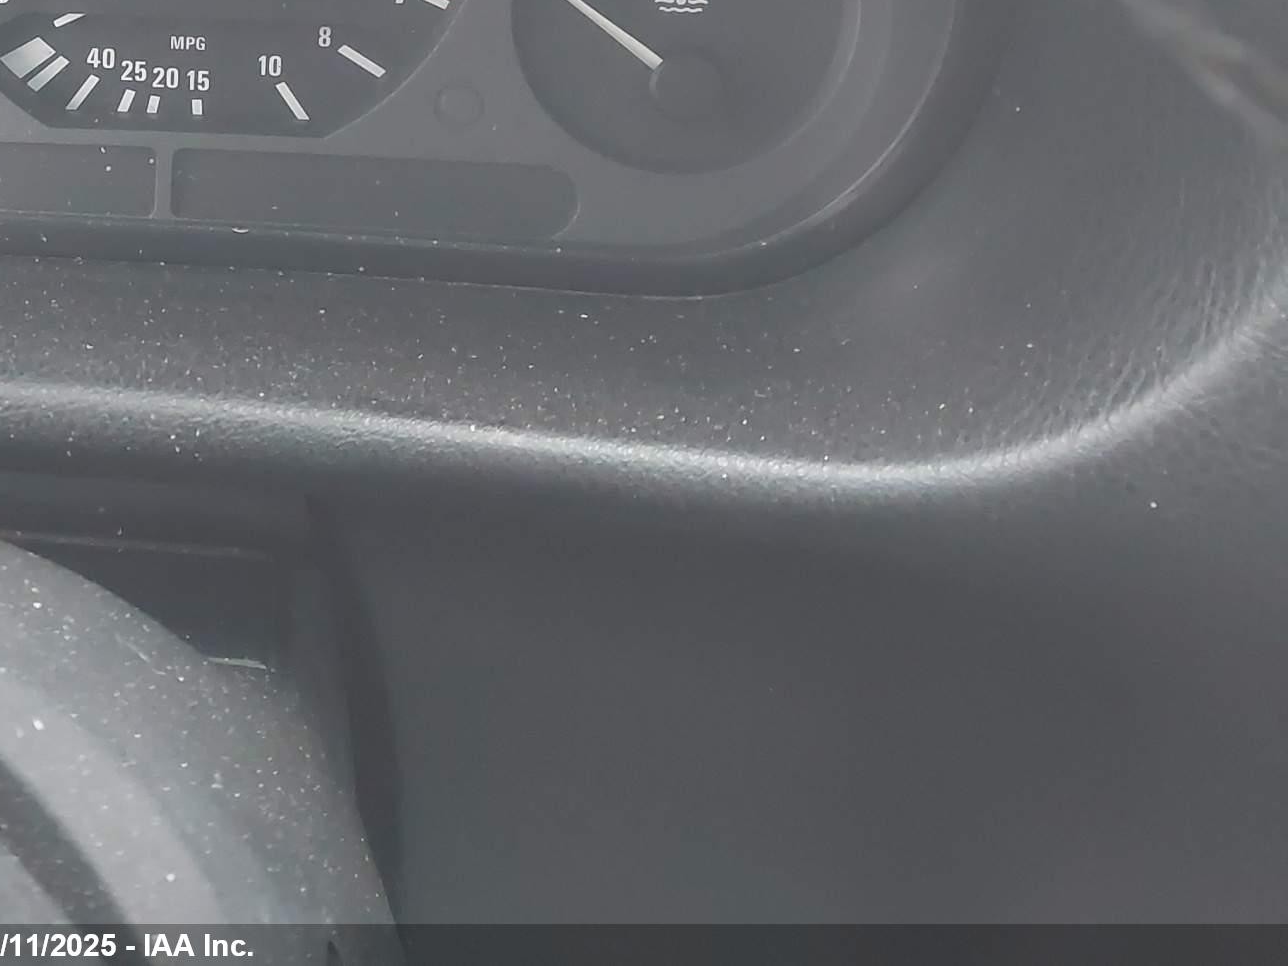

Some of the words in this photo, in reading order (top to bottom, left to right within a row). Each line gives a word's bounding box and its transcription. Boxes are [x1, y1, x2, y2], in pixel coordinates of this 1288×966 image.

[170, 35, 206, 51] MPG
[318, 26, 332, 47] 8
[86, 47, 115, 69] 40
[258, 55, 282, 77] 10
[120, 60, 147, 82] 25
[152, 67, 179, 89] 20
[186, 70, 210, 91] 15
